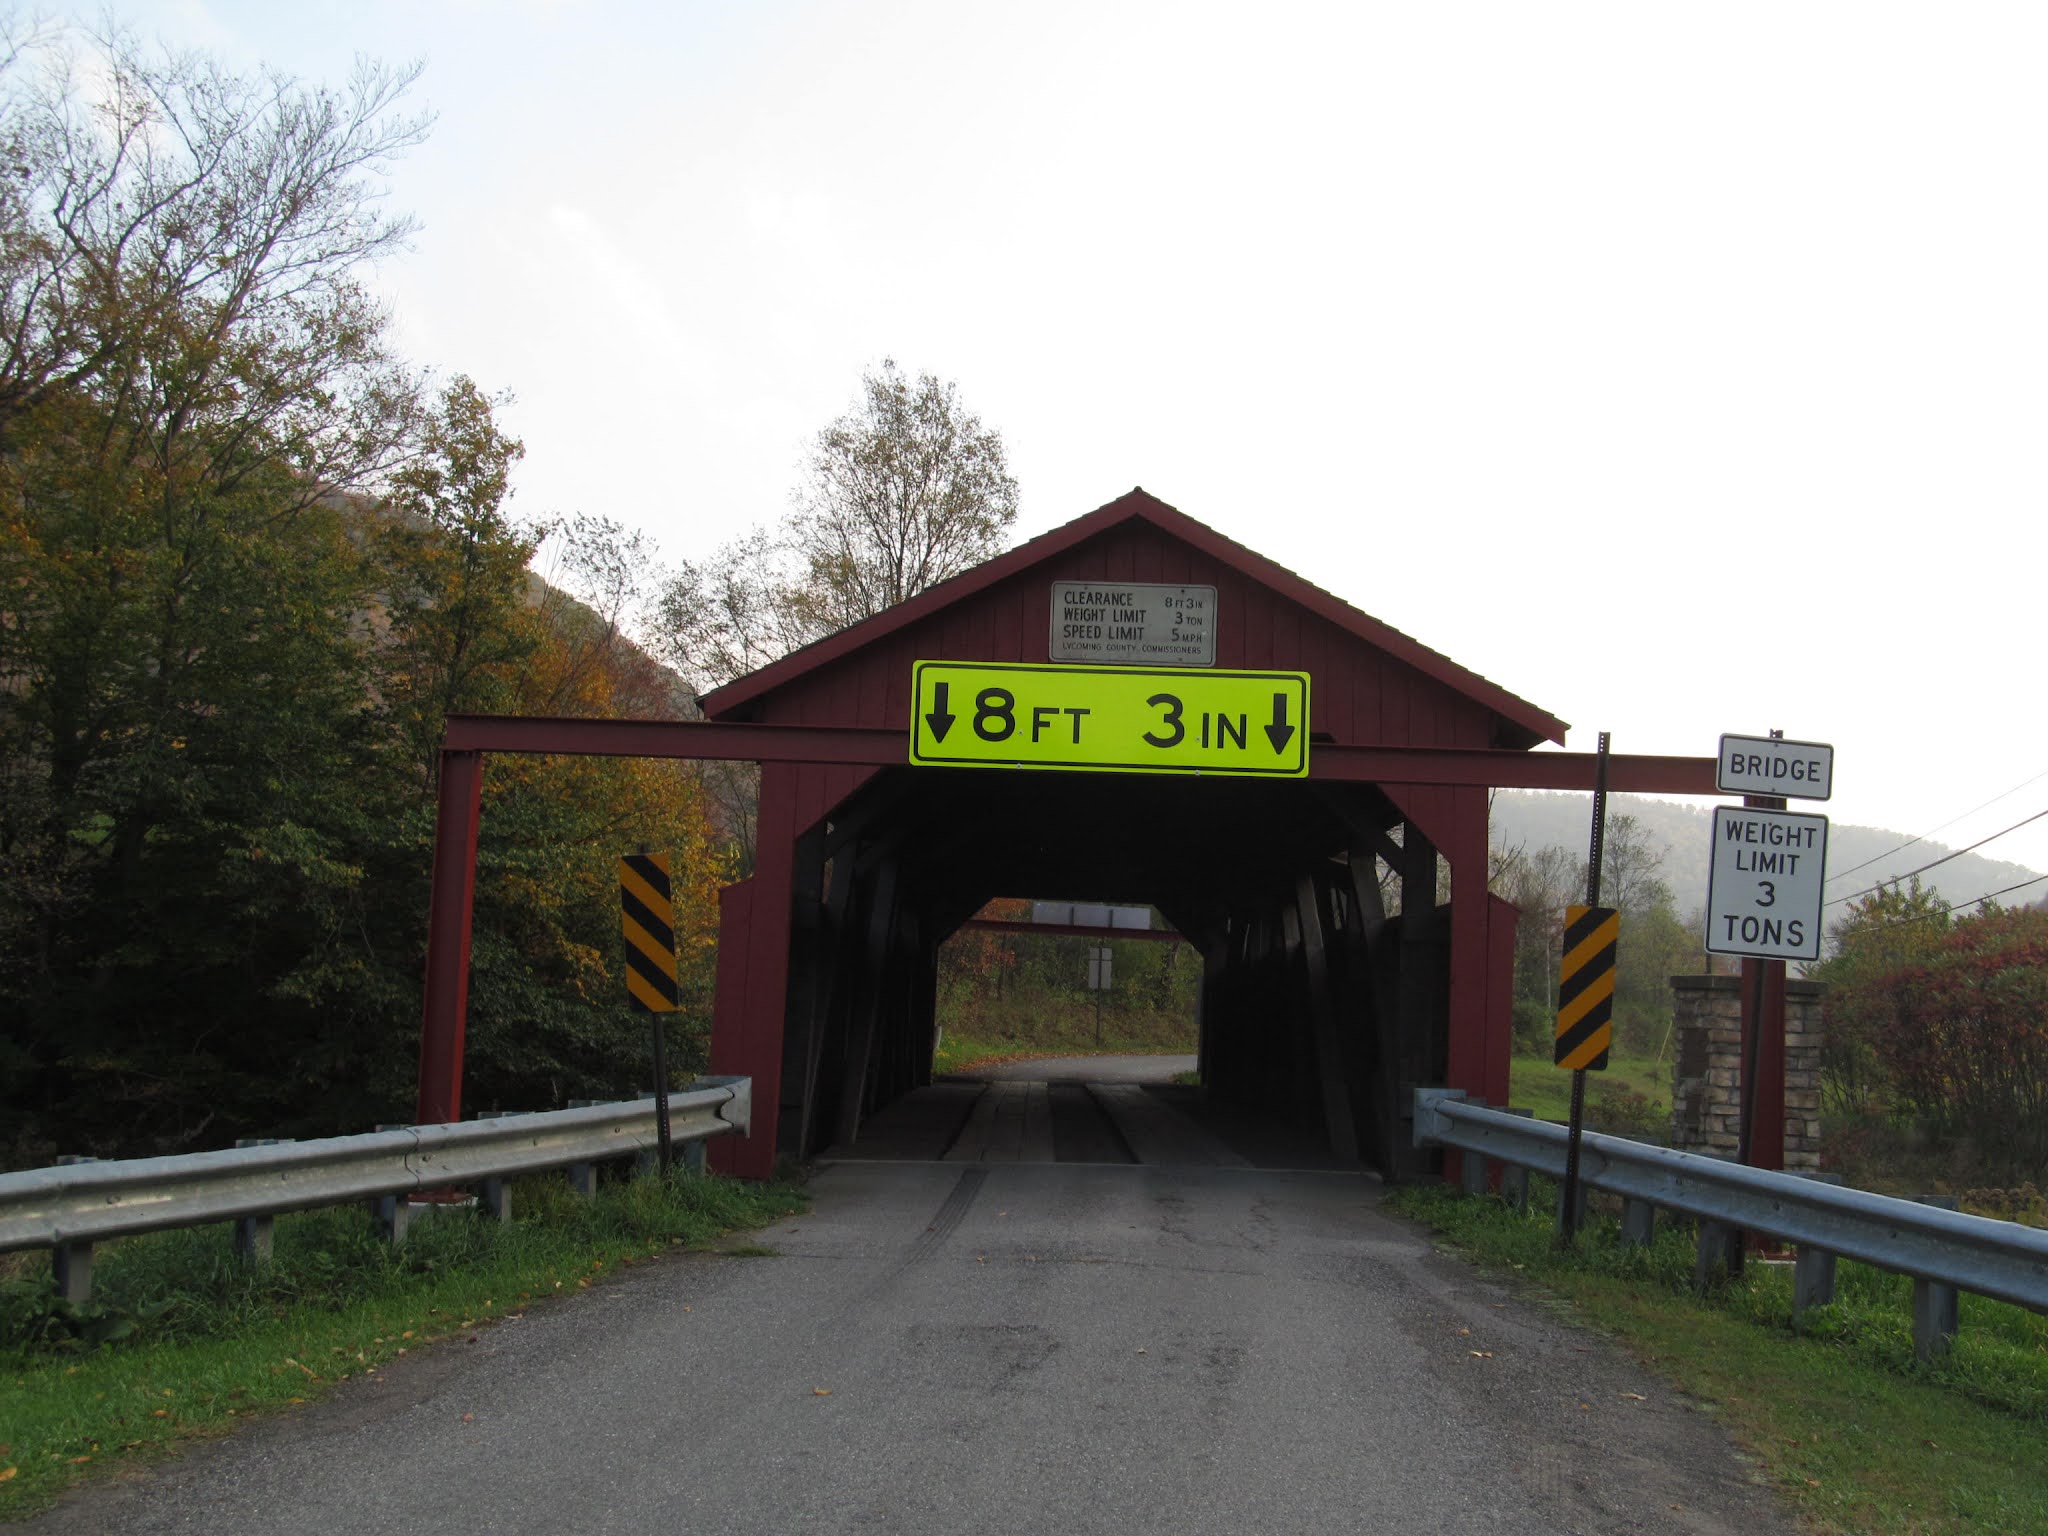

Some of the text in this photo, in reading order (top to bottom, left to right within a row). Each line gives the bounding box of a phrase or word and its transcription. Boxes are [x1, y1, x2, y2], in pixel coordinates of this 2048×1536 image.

[1064, 591, 1203, 609] CLEARANCE 8 FT 3 IN
[1064, 608, 1203, 625] WEIGHT LIMIT 3 TON
[1063, 624, 1202, 643] SPEED LIMIT 5 MPH
[1063, 642, 1202, 654] LYCOMING COUNTY COMMISSIONERS
[972, 687, 1247, 750] 8 FT 3 IN
[1731, 753, 1821, 782] BRIDGE
[1726, 820, 1817, 848] WEIGHT
[1736, 850, 1800, 875] LIMIT
[1755, 881, 1775, 907] 3
[1723, 915, 1804, 947] TONS
